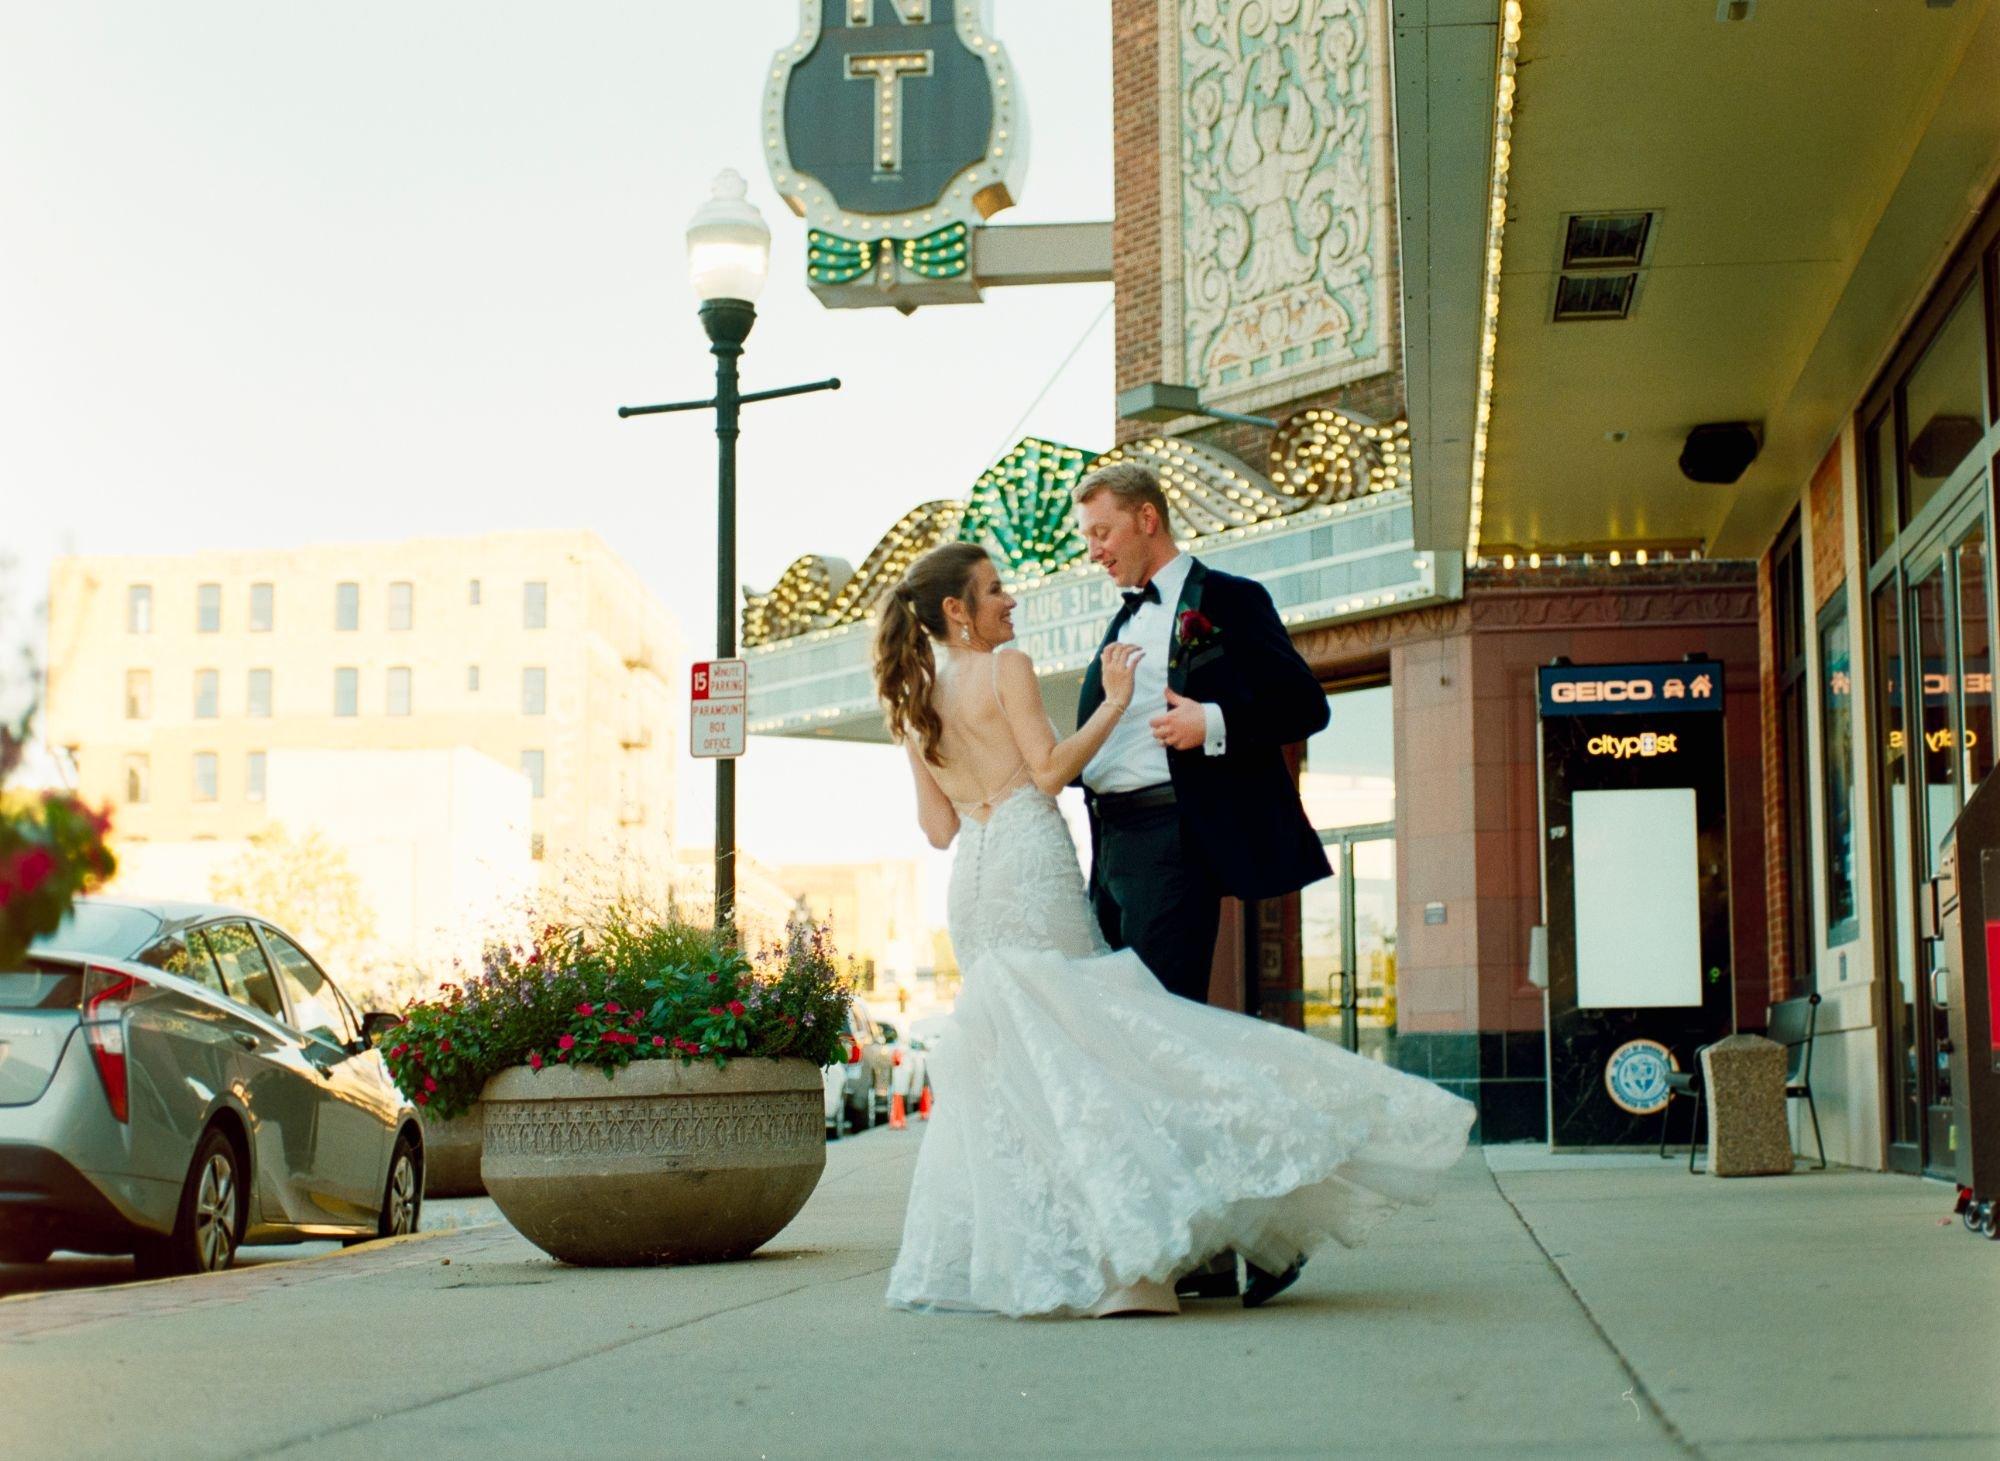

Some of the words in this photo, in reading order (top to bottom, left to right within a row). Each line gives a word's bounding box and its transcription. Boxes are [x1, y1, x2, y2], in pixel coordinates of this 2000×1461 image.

[694, 672, 708, 692] 15
[711, 680, 743, 691] PARKING
[1551, 680, 1653, 703] GEICO
[693, 704, 743, 717] PARAMOUNT
[709, 721, 726, 733] BOX
[704, 738, 732, 749] OFFICE
